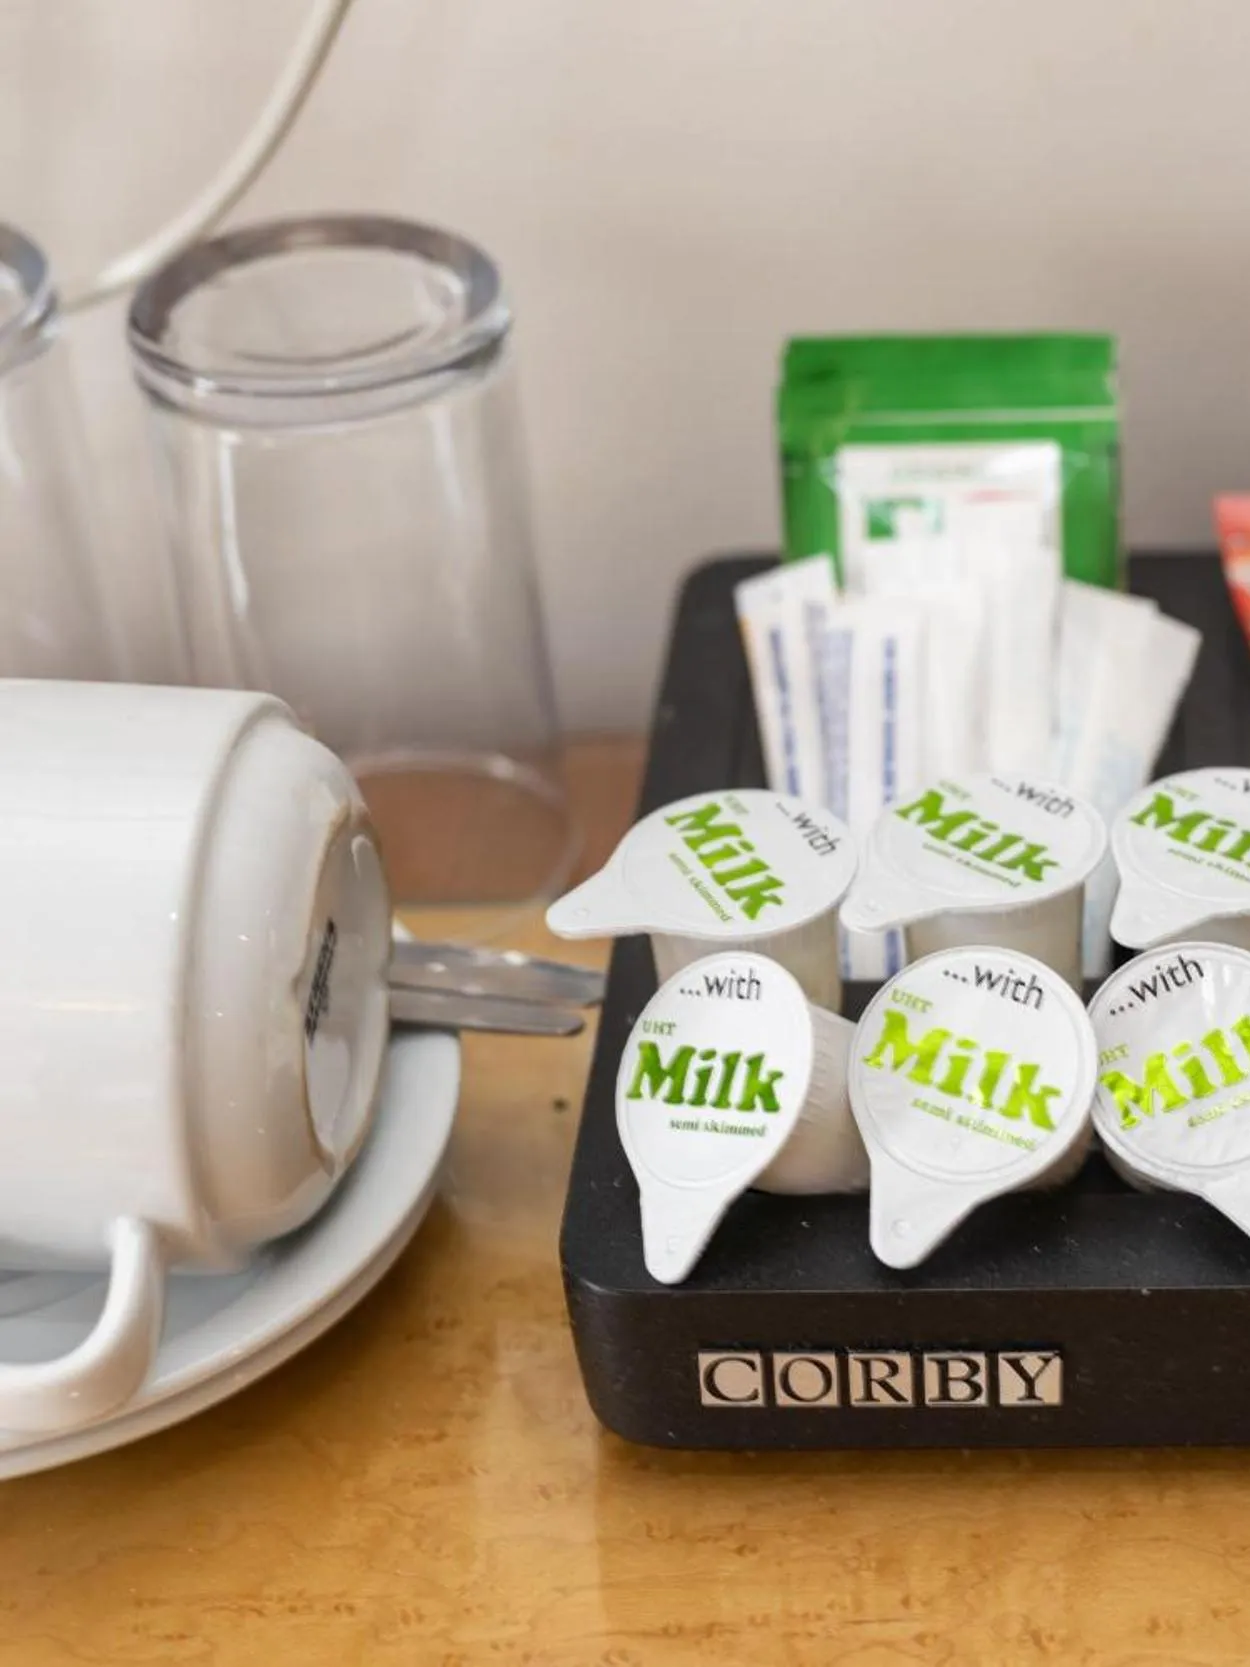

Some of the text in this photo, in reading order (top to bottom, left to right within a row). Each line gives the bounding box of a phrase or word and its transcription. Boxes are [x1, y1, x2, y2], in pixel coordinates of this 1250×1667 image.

[663, 801, 786, 921] Milk
[894, 788, 1061, 882] Milk
[679, 967, 761, 1001] ...with
[943, 964, 1044, 1010] ...with
[1109, 953, 1205, 1016] ...with
[641, 1019, 677, 1037] UHT
[625, 1039, 785, 1114] Milk
[861, 1009, 1063, 1132] Milk
[669, 1119, 767, 1138] semi skimmed
[701, 1353, 1059, 1405] CORBY
